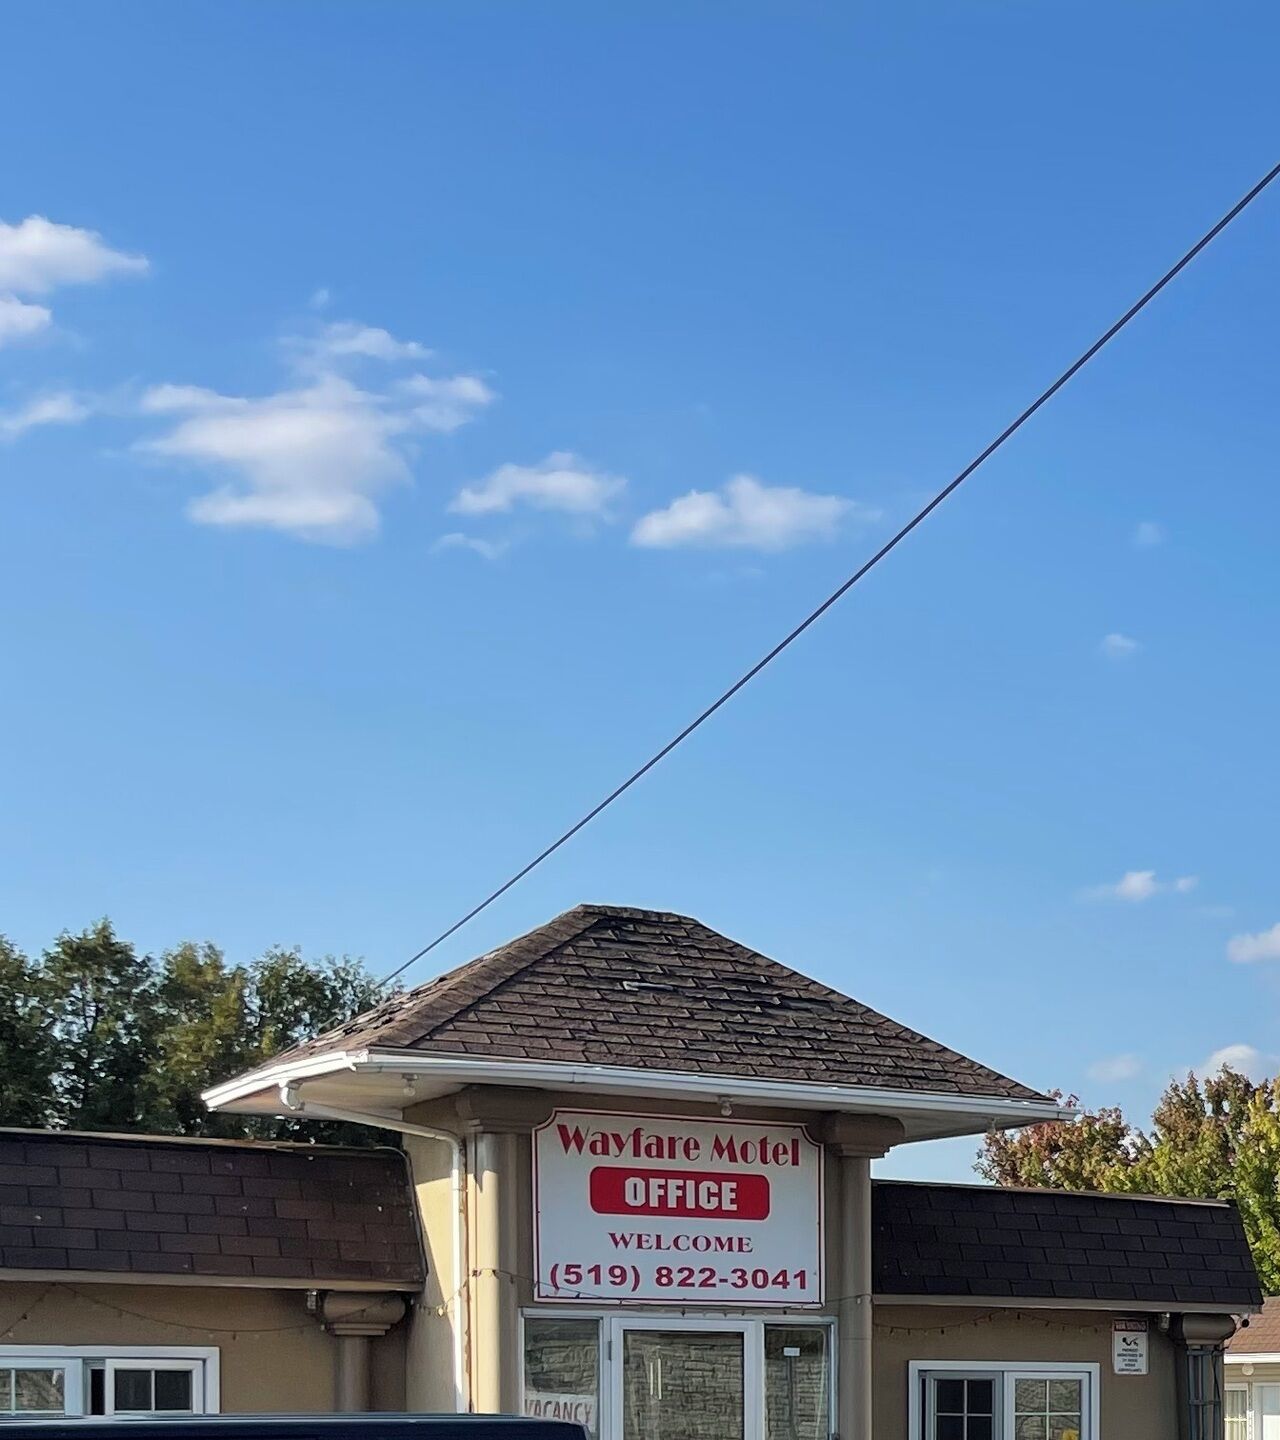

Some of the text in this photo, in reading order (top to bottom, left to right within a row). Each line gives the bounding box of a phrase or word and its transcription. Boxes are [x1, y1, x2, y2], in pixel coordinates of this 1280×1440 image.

[557, 1124, 800, 1167] Wayfare Motel
[624, 1176, 738, 1212] OFFICE
[608, 1232, 754, 1254] WELCOME
[549, 1263, 807, 1292] (519) 822-3041
[525, 1399, 592, 1424] VACANCY
